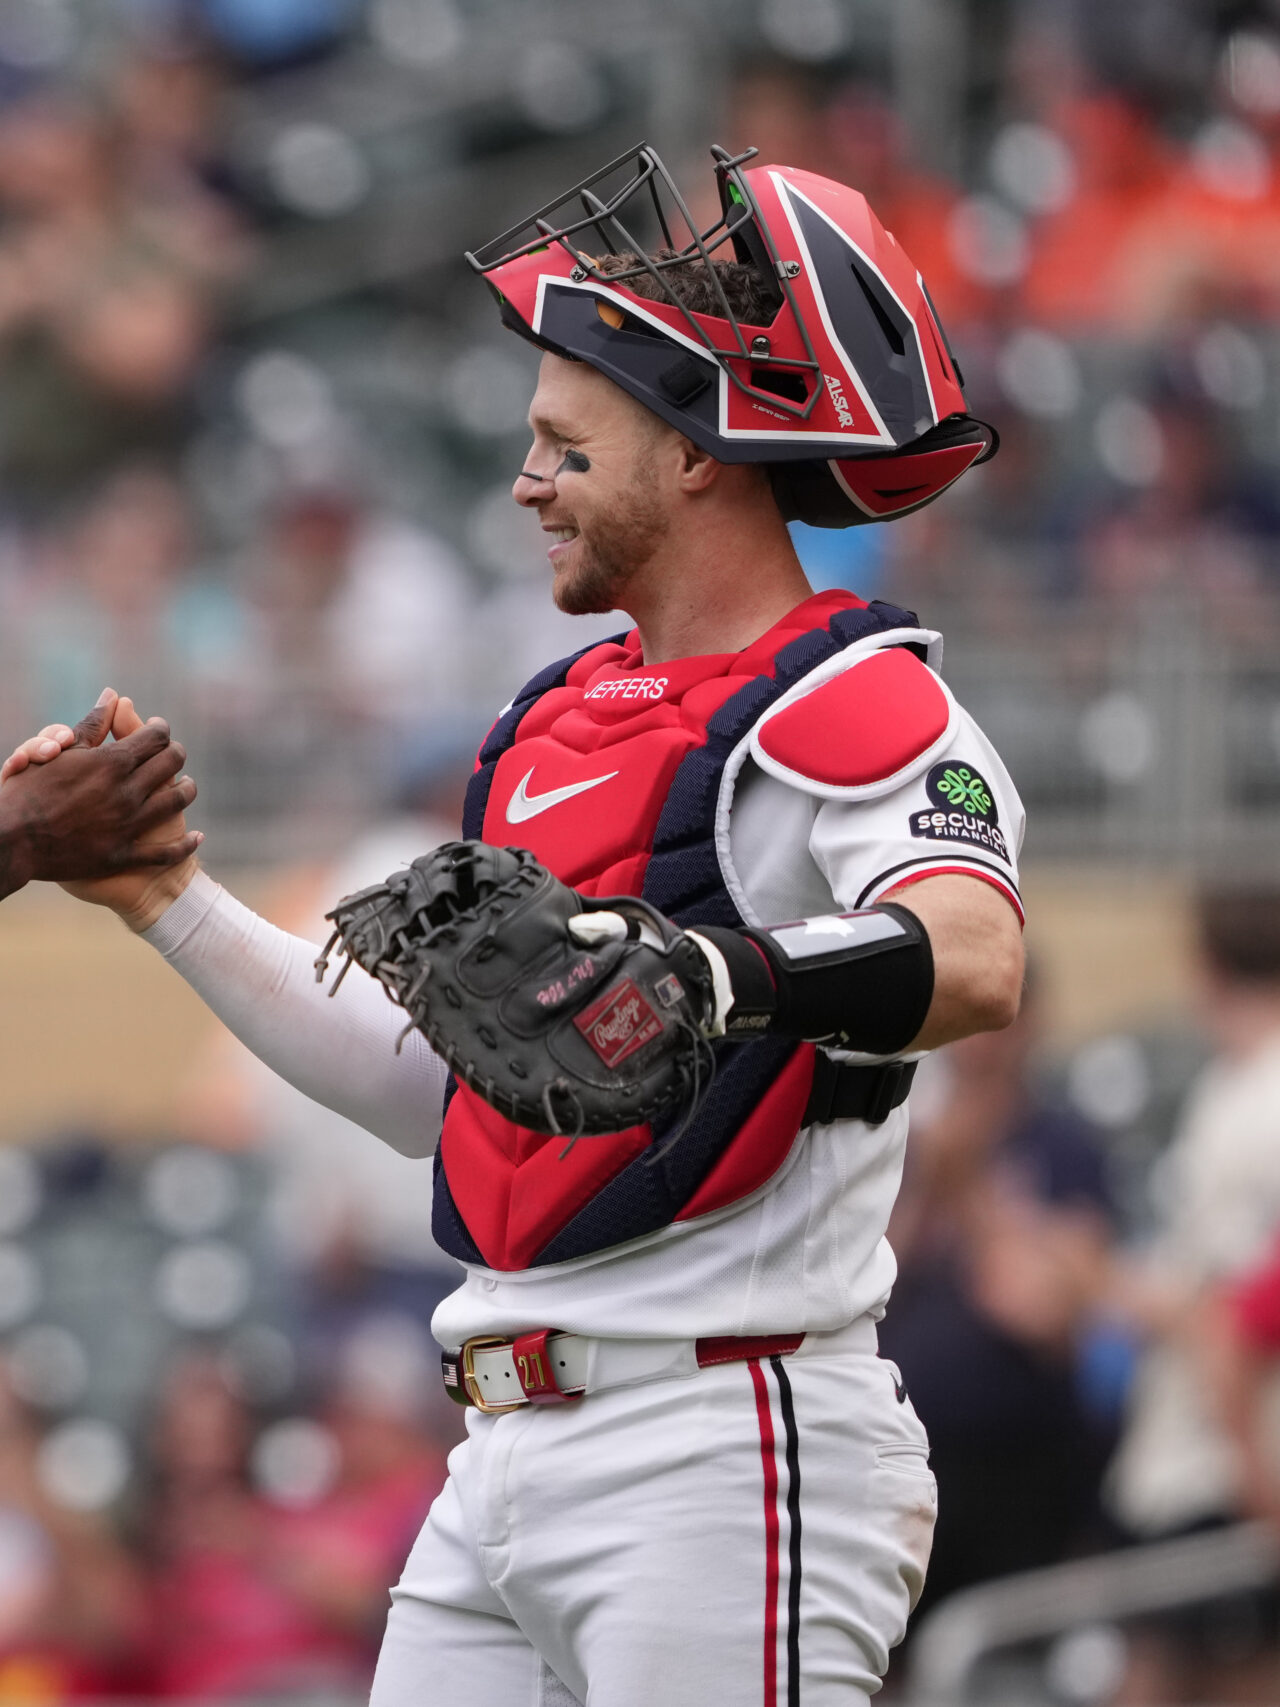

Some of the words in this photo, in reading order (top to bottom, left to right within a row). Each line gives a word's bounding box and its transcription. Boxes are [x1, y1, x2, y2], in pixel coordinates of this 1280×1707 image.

[584, 677, 669, 699] JEFFERS
[593, 996, 640, 1048] Rawlings
[518, 1353, 545, 1389] 27
